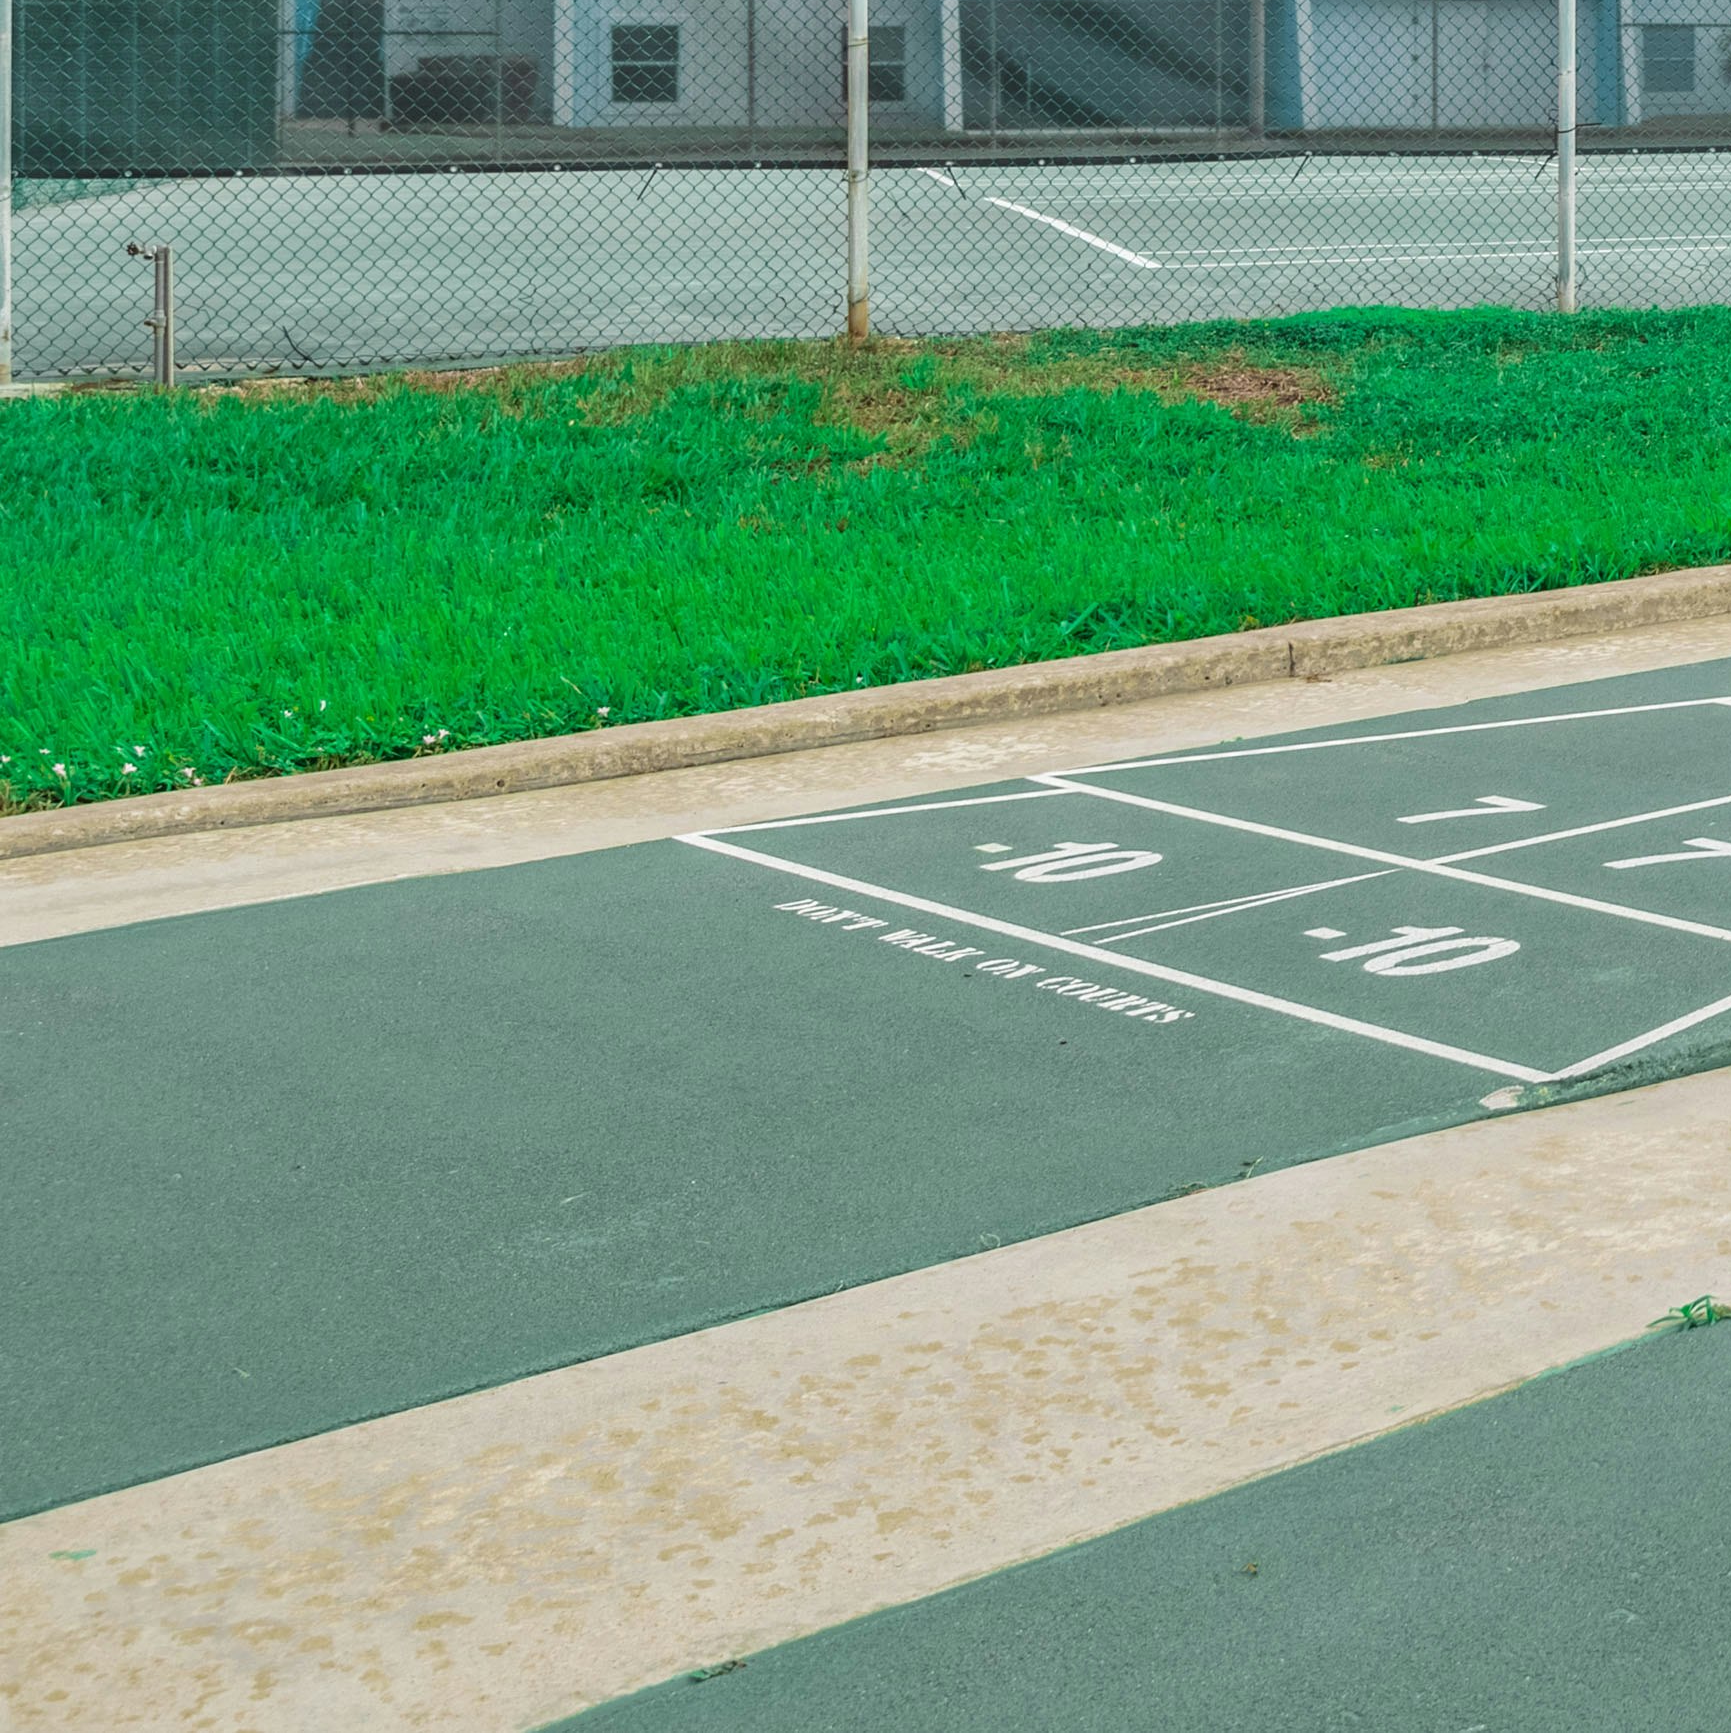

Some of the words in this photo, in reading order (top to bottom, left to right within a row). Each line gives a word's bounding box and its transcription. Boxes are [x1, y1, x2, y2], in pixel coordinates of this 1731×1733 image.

[1396, 794, 1547, 824] 7
[974, 841, 1163, 883] -10
[1304, 924, 1520, 977] -10
[877, 929, 986, 963] WALK
[976, 958, 1046, 981] ON
[1037, 975, 1195, 1024] COURTS
